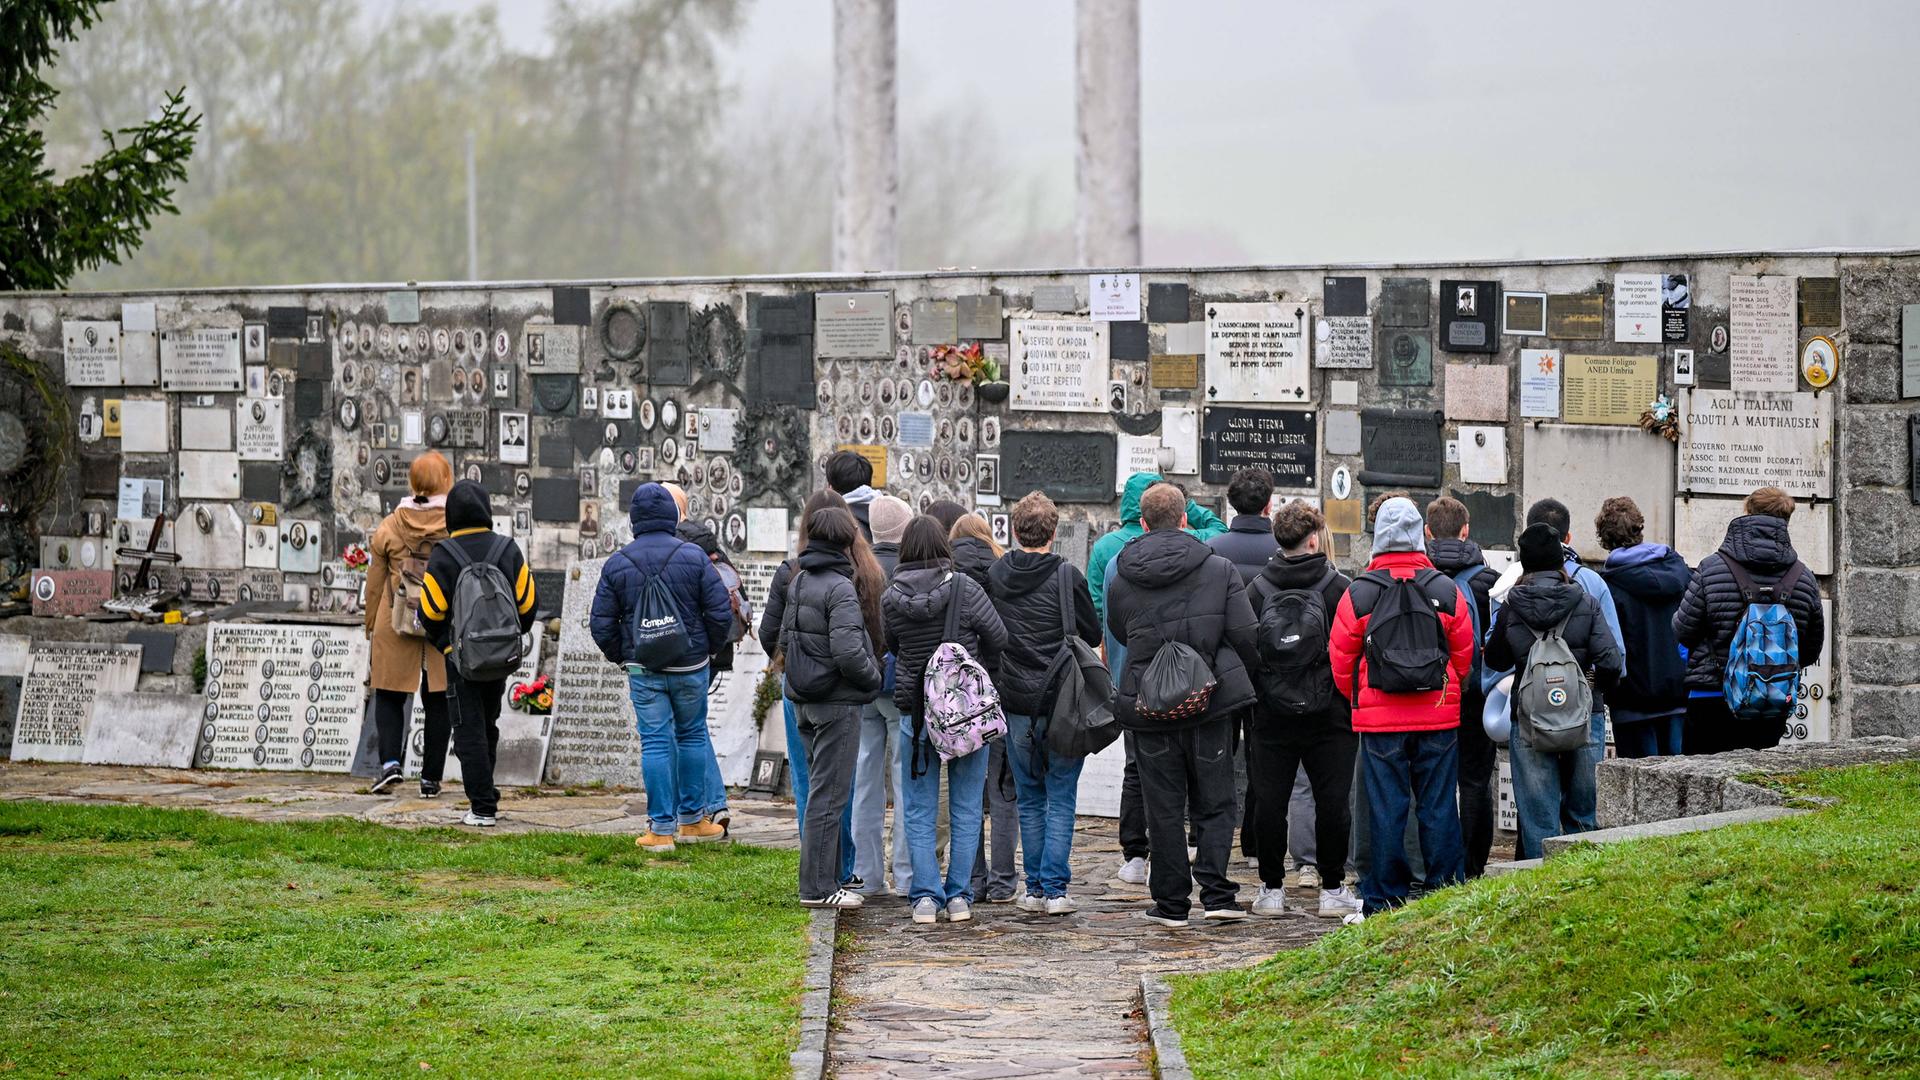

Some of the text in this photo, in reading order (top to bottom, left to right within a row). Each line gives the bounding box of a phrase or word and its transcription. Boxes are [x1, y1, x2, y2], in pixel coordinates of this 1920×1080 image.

[1030, 337, 1087, 346] SEVERO CAMPORA
[1030, 351, 1090, 359] GIOVANNI CAMPORA
[1584, 357, 1637, 367] Comune Foligno
[1029, 364, 1081, 373] GIO BATTA BISIO
[1587, 366, 1634, 375] ANED Umbria
[1029, 376, 1081, 386] FELICE REPETTO
[1711, 399, 1792, 411] AGLI ITALIANI
[1228, 418, 1284, 430] GLORIA ETERNA
[1687, 413, 1819, 428] CADUTI A MAUTHAUSEN
[1210, 432, 1217, 441] AI
[1222, 432, 1246, 442] CADUTI
[1250, 433, 1262, 443] PER
[1266, 433, 1275, 444] LA
[1731, 444, 1764, 452] ITALIANO
[1272, 452, 1296, 460] COMUNALE
[1767, 458, 1802, 466] DECORATI
[1277, 464, 1306, 474] GIOVANNI
[1719, 466, 1826, 478] NAZIONALE COMUNI ITALIANI
[1719, 477, 1739, 486] DELLE
[1744, 479, 1780, 487] PROVINCIE
[297, 630, 331, 638] CITTADINI
[226, 637, 266, 645] MONTELUPO
[326, 639, 348, 647] GIANNI
[39, 648, 68, 656] COMUNE
[237, 646, 272, 654] DEPORTATI
[325, 648, 349, 656] SANZIO
[276, 660, 300, 668] FIORINI
[28, 672, 63, 680] BAGNASCO
[275, 669, 309, 677] GALLIANO
[222, 682, 248, 690] BARDINI
[322, 685, 356, 693] MANNOZZI
[25, 694, 68, 702] COMPOSTINI
[222, 691, 238, 699] LUIGI
[220, 704, 253, 712] BARONCINI
[320, 707, 357, 715] MIGLIORINI
[218, 713, 254, 721] MARCELLO
[271, 714, 293, 722] DANTE
[318, 716, 348, 724] AMEDEO
[217, 725, 249, 734] CACIALLI
[217, 734, 249, 742] TOMMASO
[268, 736, 299, 744] ROBERTO
[316, 749, 351, 757] TANGORRA
[214, 755, 238, 763] CARLO
[266, 757, 293, 765] ERASMO
[314, 758, 346, 767] GIUSEPPE
